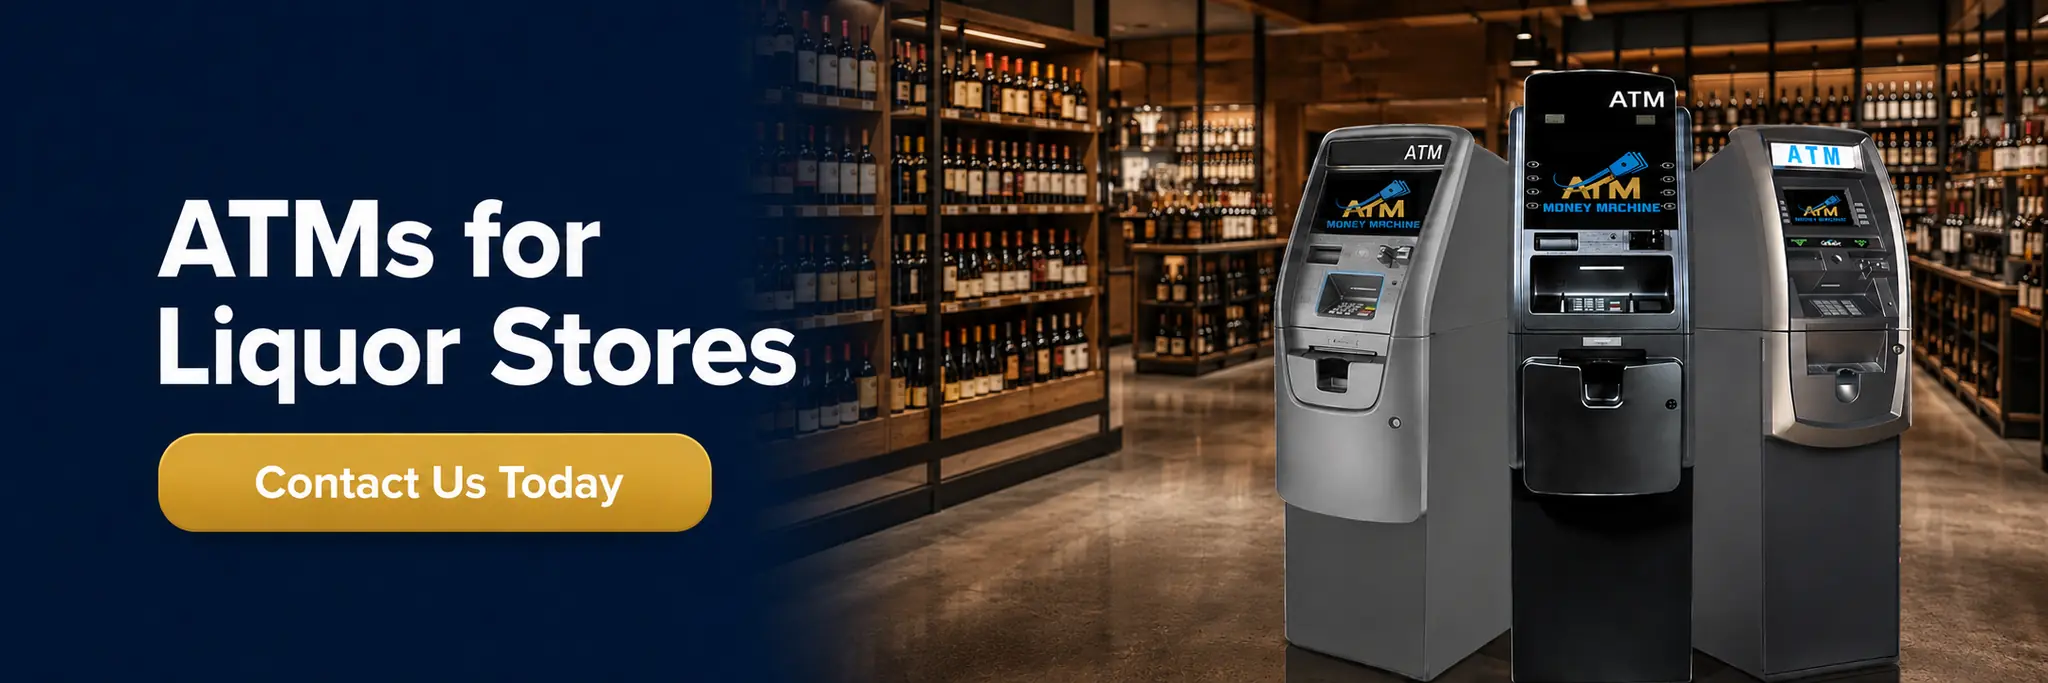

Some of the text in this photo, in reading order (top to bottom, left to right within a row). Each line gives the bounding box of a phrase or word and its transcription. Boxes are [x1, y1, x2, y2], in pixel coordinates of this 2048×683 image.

[1608, 90, 1665, 108] ATM
[1403, 144, 1443, 161] ATM
[1787, 144, 1841, 166] ATM
[1561, 174, 1641, 200] ATM
[1342, 198, 1405, 218] ATM
[1543, 202, 1661, 213] MONEY MACHINE
[1803, 205, 1838, 217] ATM
[1326, 220, 1421, 229] MONEY MACHINE
